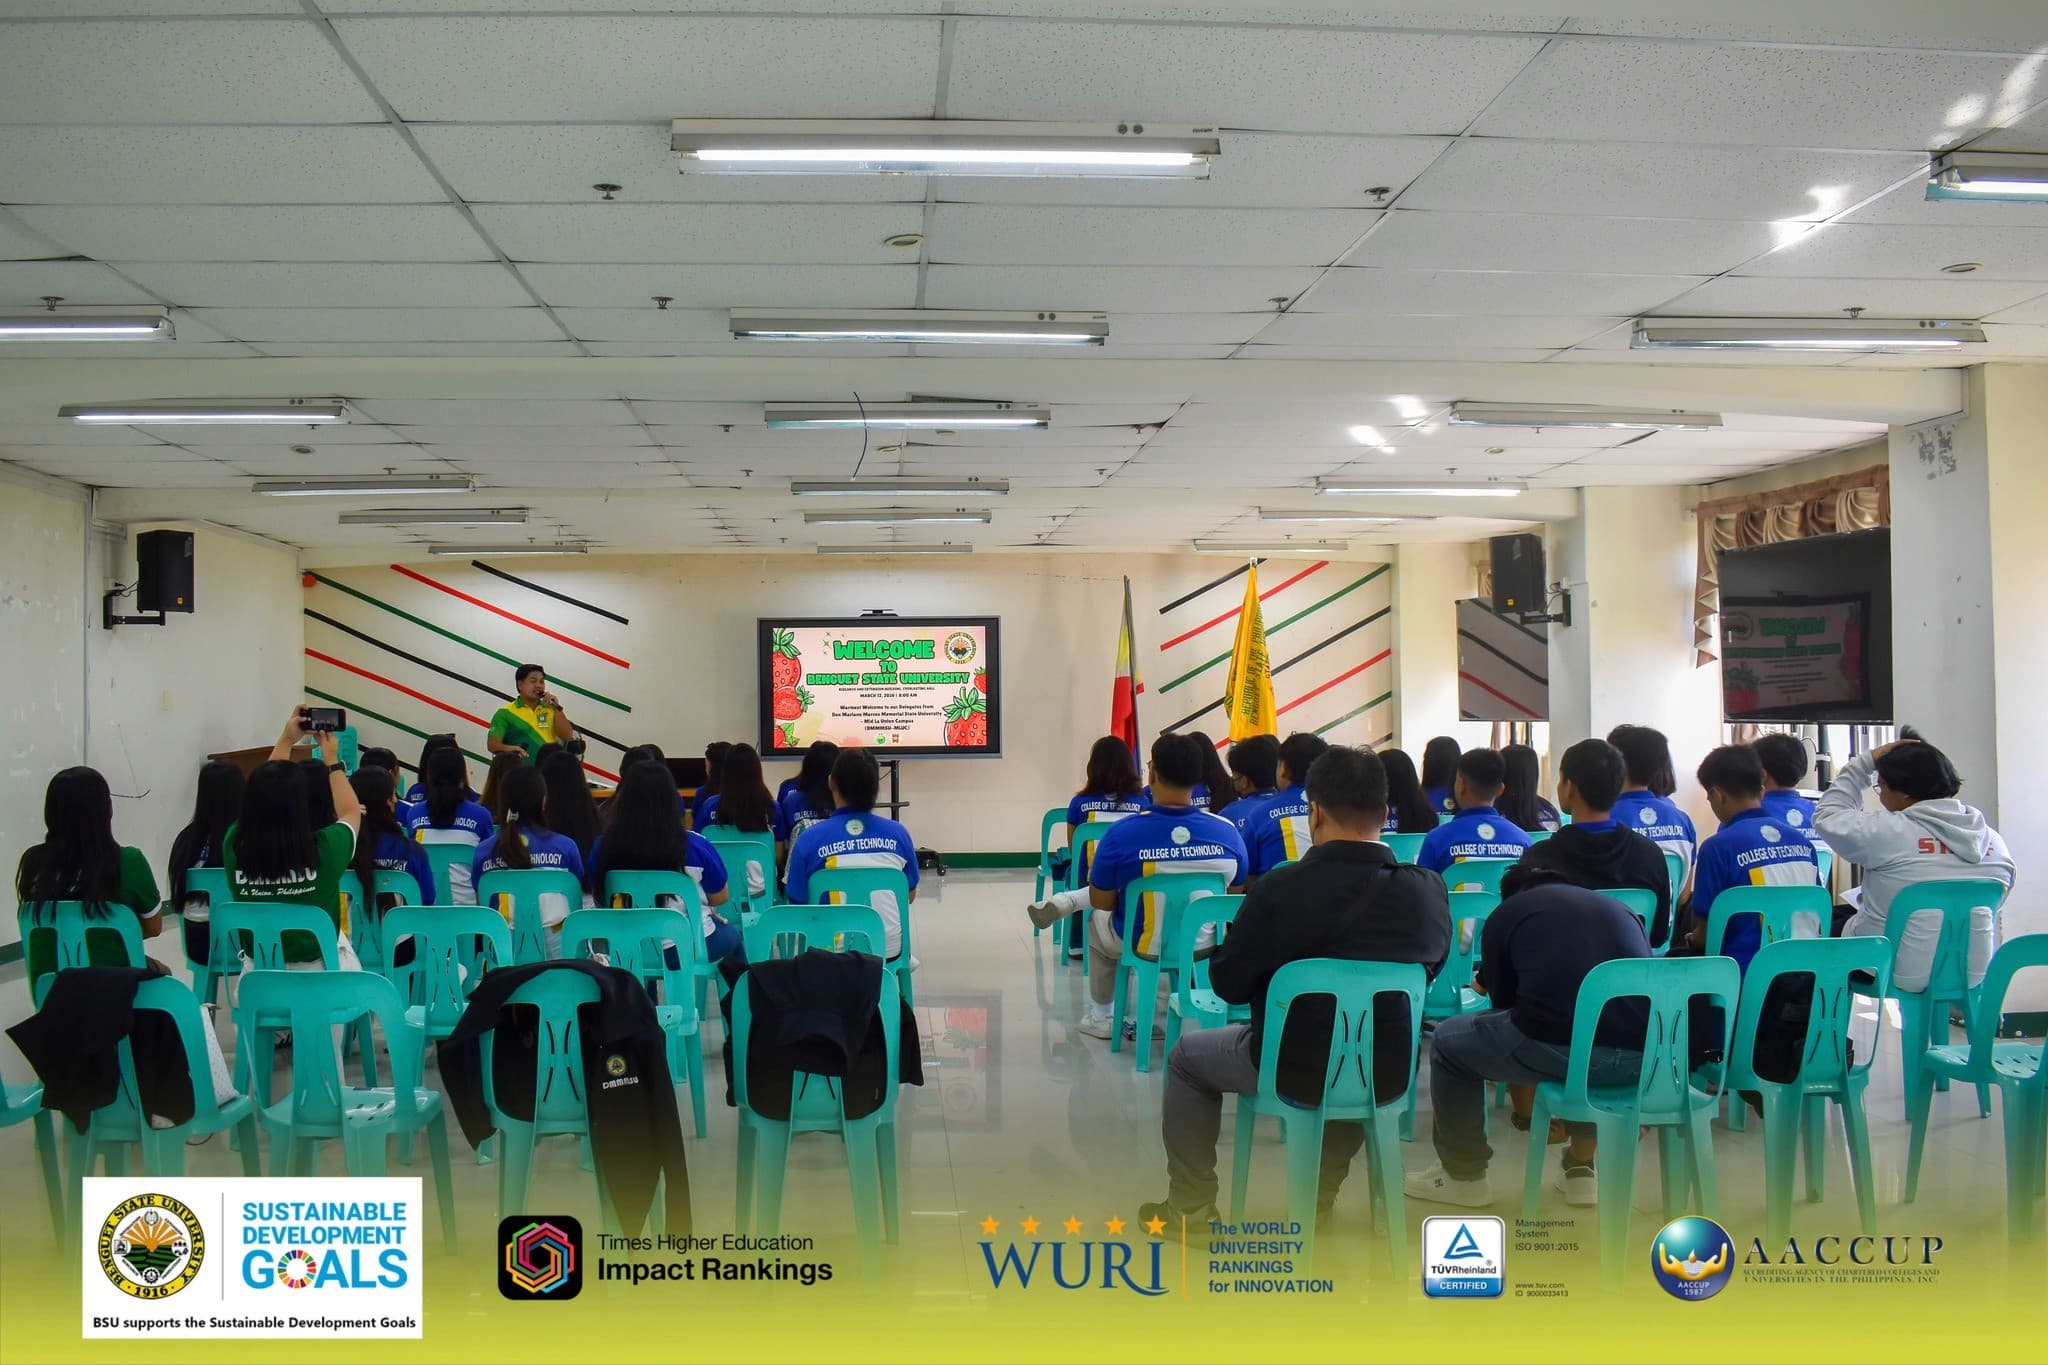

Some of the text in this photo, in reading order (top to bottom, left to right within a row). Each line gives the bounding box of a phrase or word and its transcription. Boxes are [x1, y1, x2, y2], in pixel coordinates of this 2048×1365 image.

[833, 640, 935, 660] WELCOME
[879, 660, 898, 673] TO
[806, 672, 970, 685] BENGUET STATE UNIVERSITY
[1081, 801, 1101, 812] COLLEGE
[1269, 804, 1309, 819] COLLEGE OF
[818, 837, 897, 858] COLLEGE OF TECHNOLOGY
[1139, 848, 1169, 860] COLLEGE
[1170, 847, 1180, 858] OF
[1450, 845, 1478, 856] COLLEGE
[1478, 844, 1487, 855] OF
[1737, 848, 1769, 867] COLLEGE
[1767, 847, 1777, 859] OF
